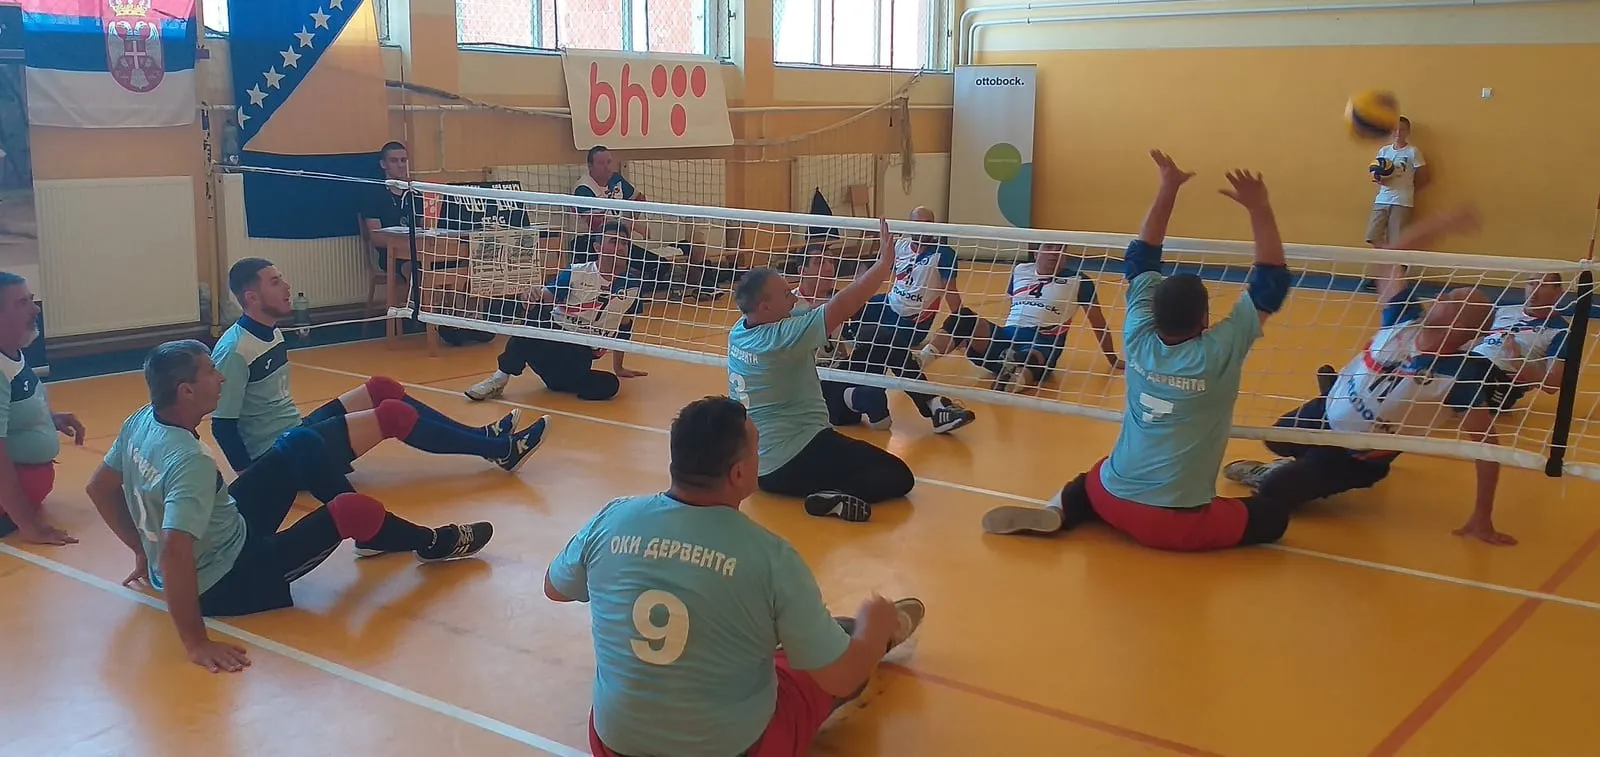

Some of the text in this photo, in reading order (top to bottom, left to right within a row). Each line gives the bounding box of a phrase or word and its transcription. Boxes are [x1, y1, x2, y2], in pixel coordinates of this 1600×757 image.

[975, 76, 1025, 86] ottobock.
[1029, 282, 1043, 299] 4
[610, 535, 738, 577] ОКИ ДЕРВЕНТА
[629, 588, 691, 666] 9
